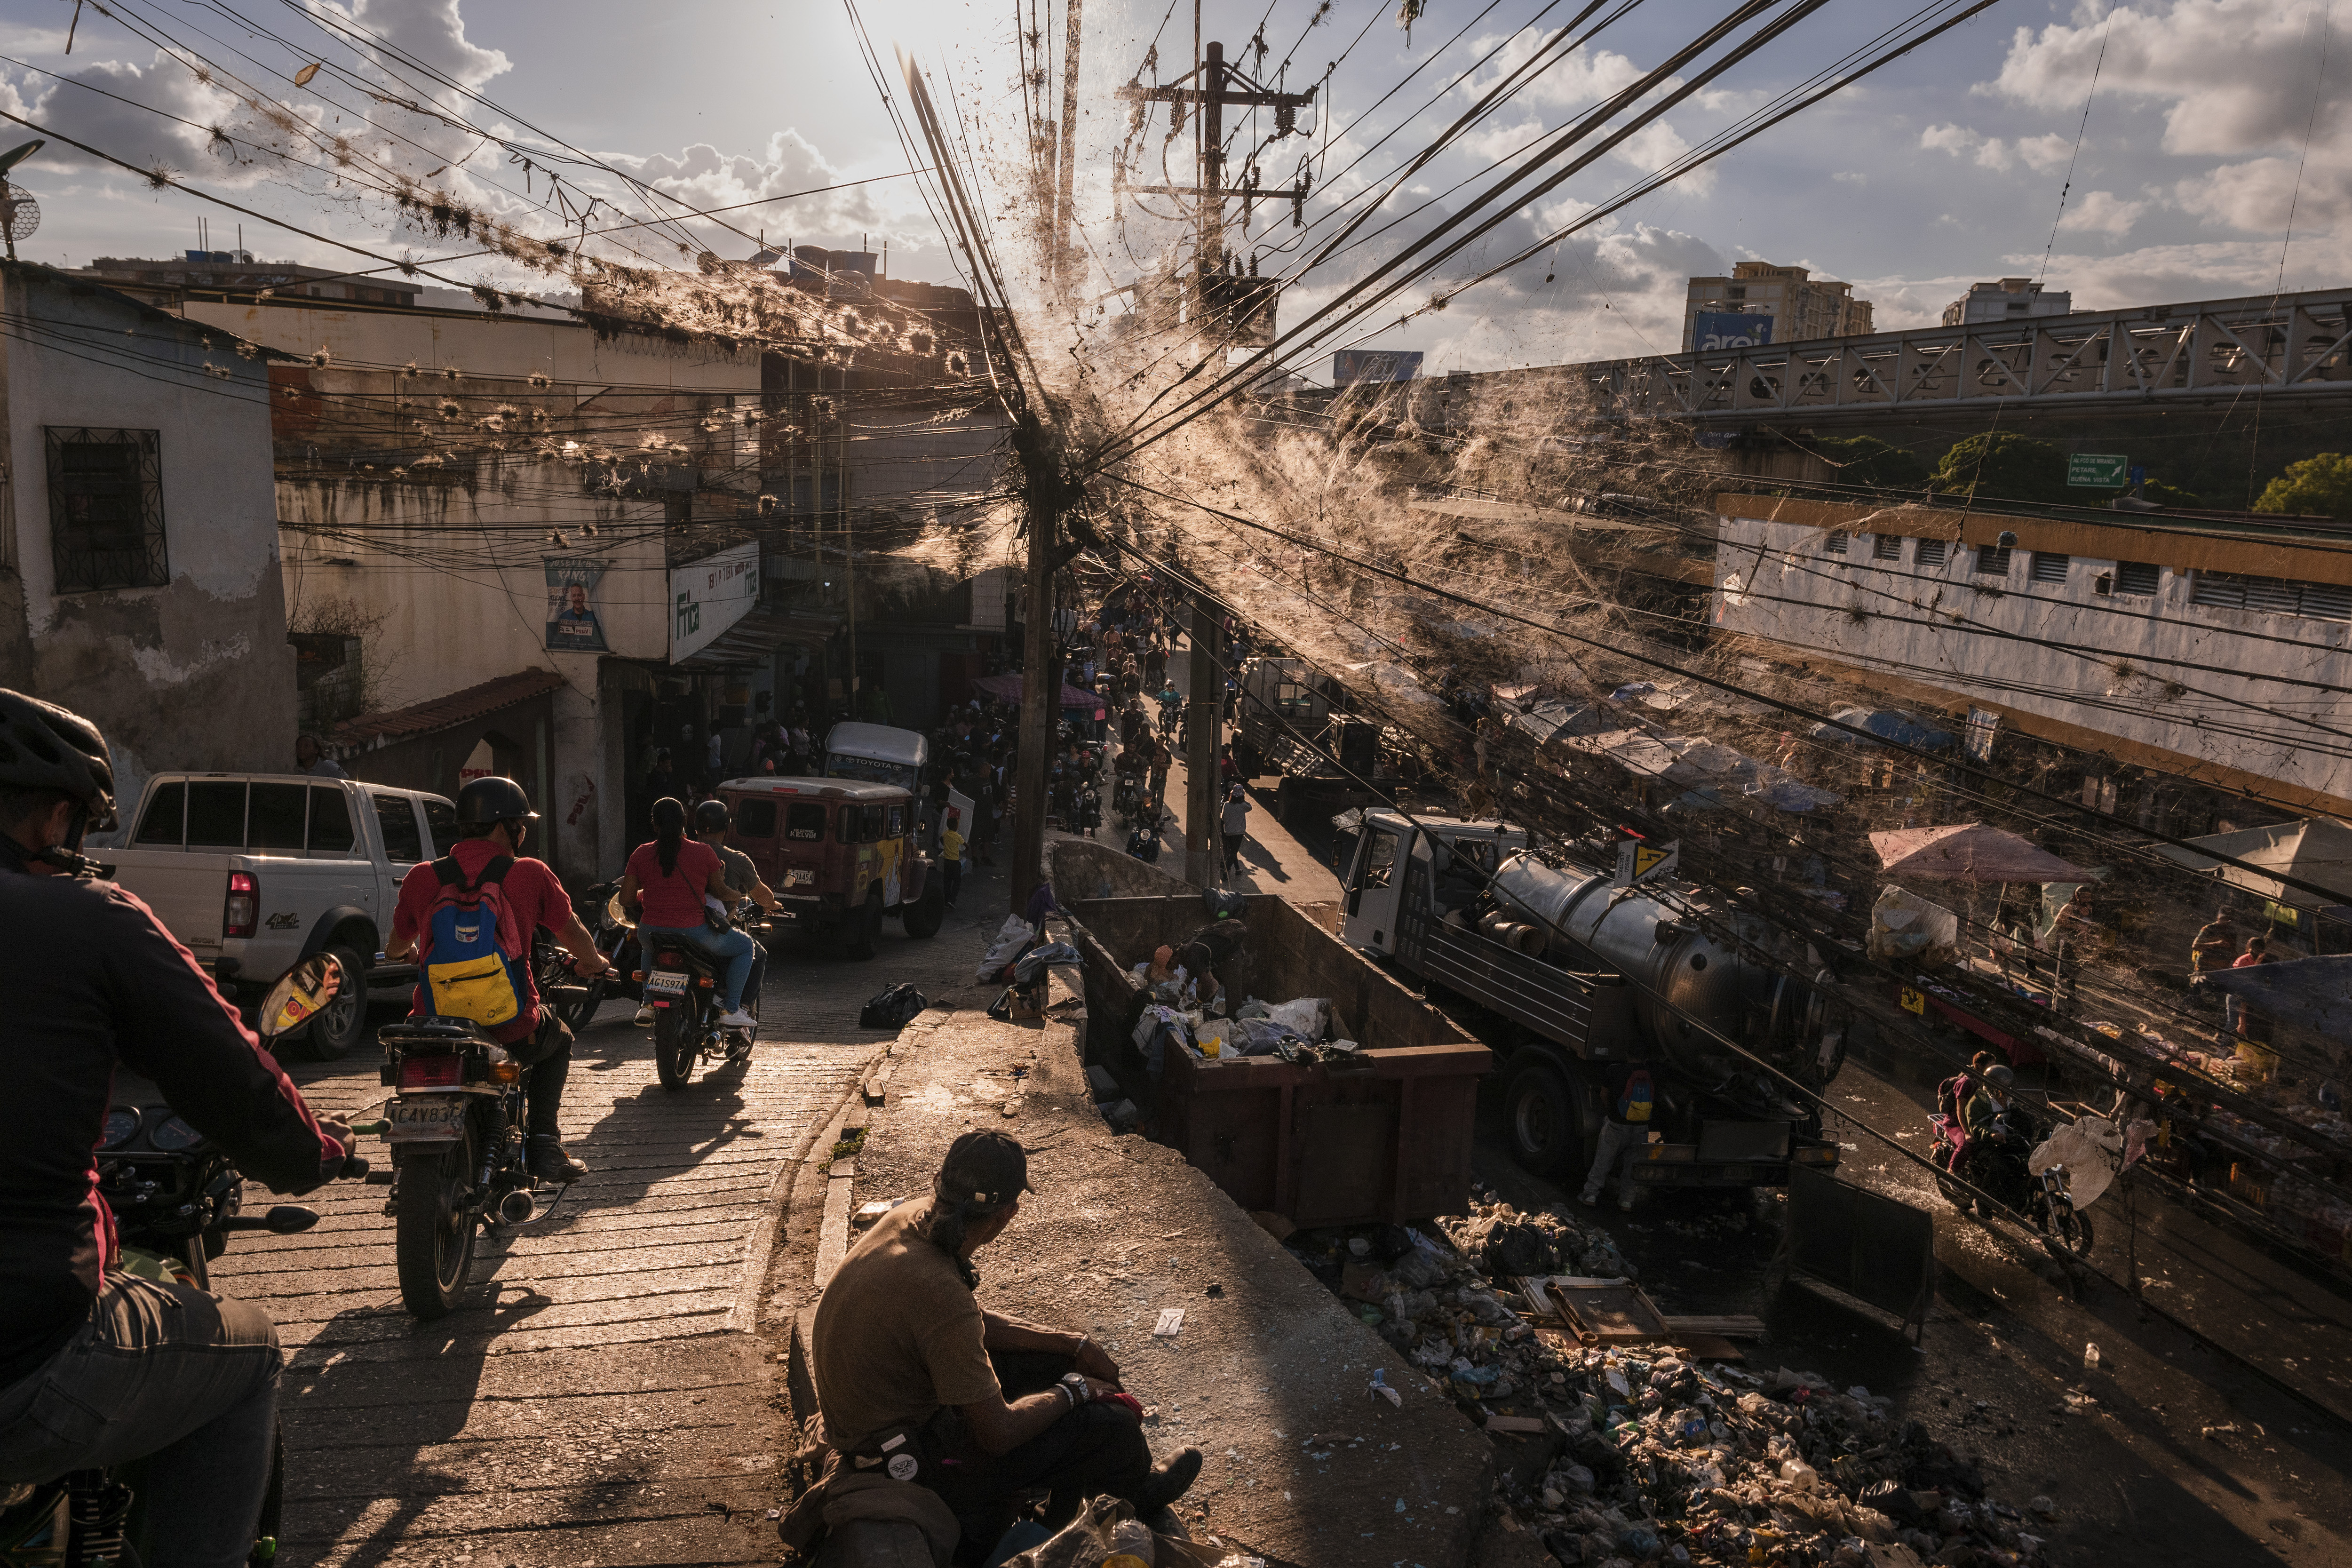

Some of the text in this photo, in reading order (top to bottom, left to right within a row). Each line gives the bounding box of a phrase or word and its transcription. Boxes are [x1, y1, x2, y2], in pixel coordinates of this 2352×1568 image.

[745, 559, 757, 597] Frica
[677, 589, 699, 640] Frica
[855, 758, 892, 769] TOYOTA
[789, 871, 813, 882] 3A45A
[649, 977, 684, 990] AG1S97A
